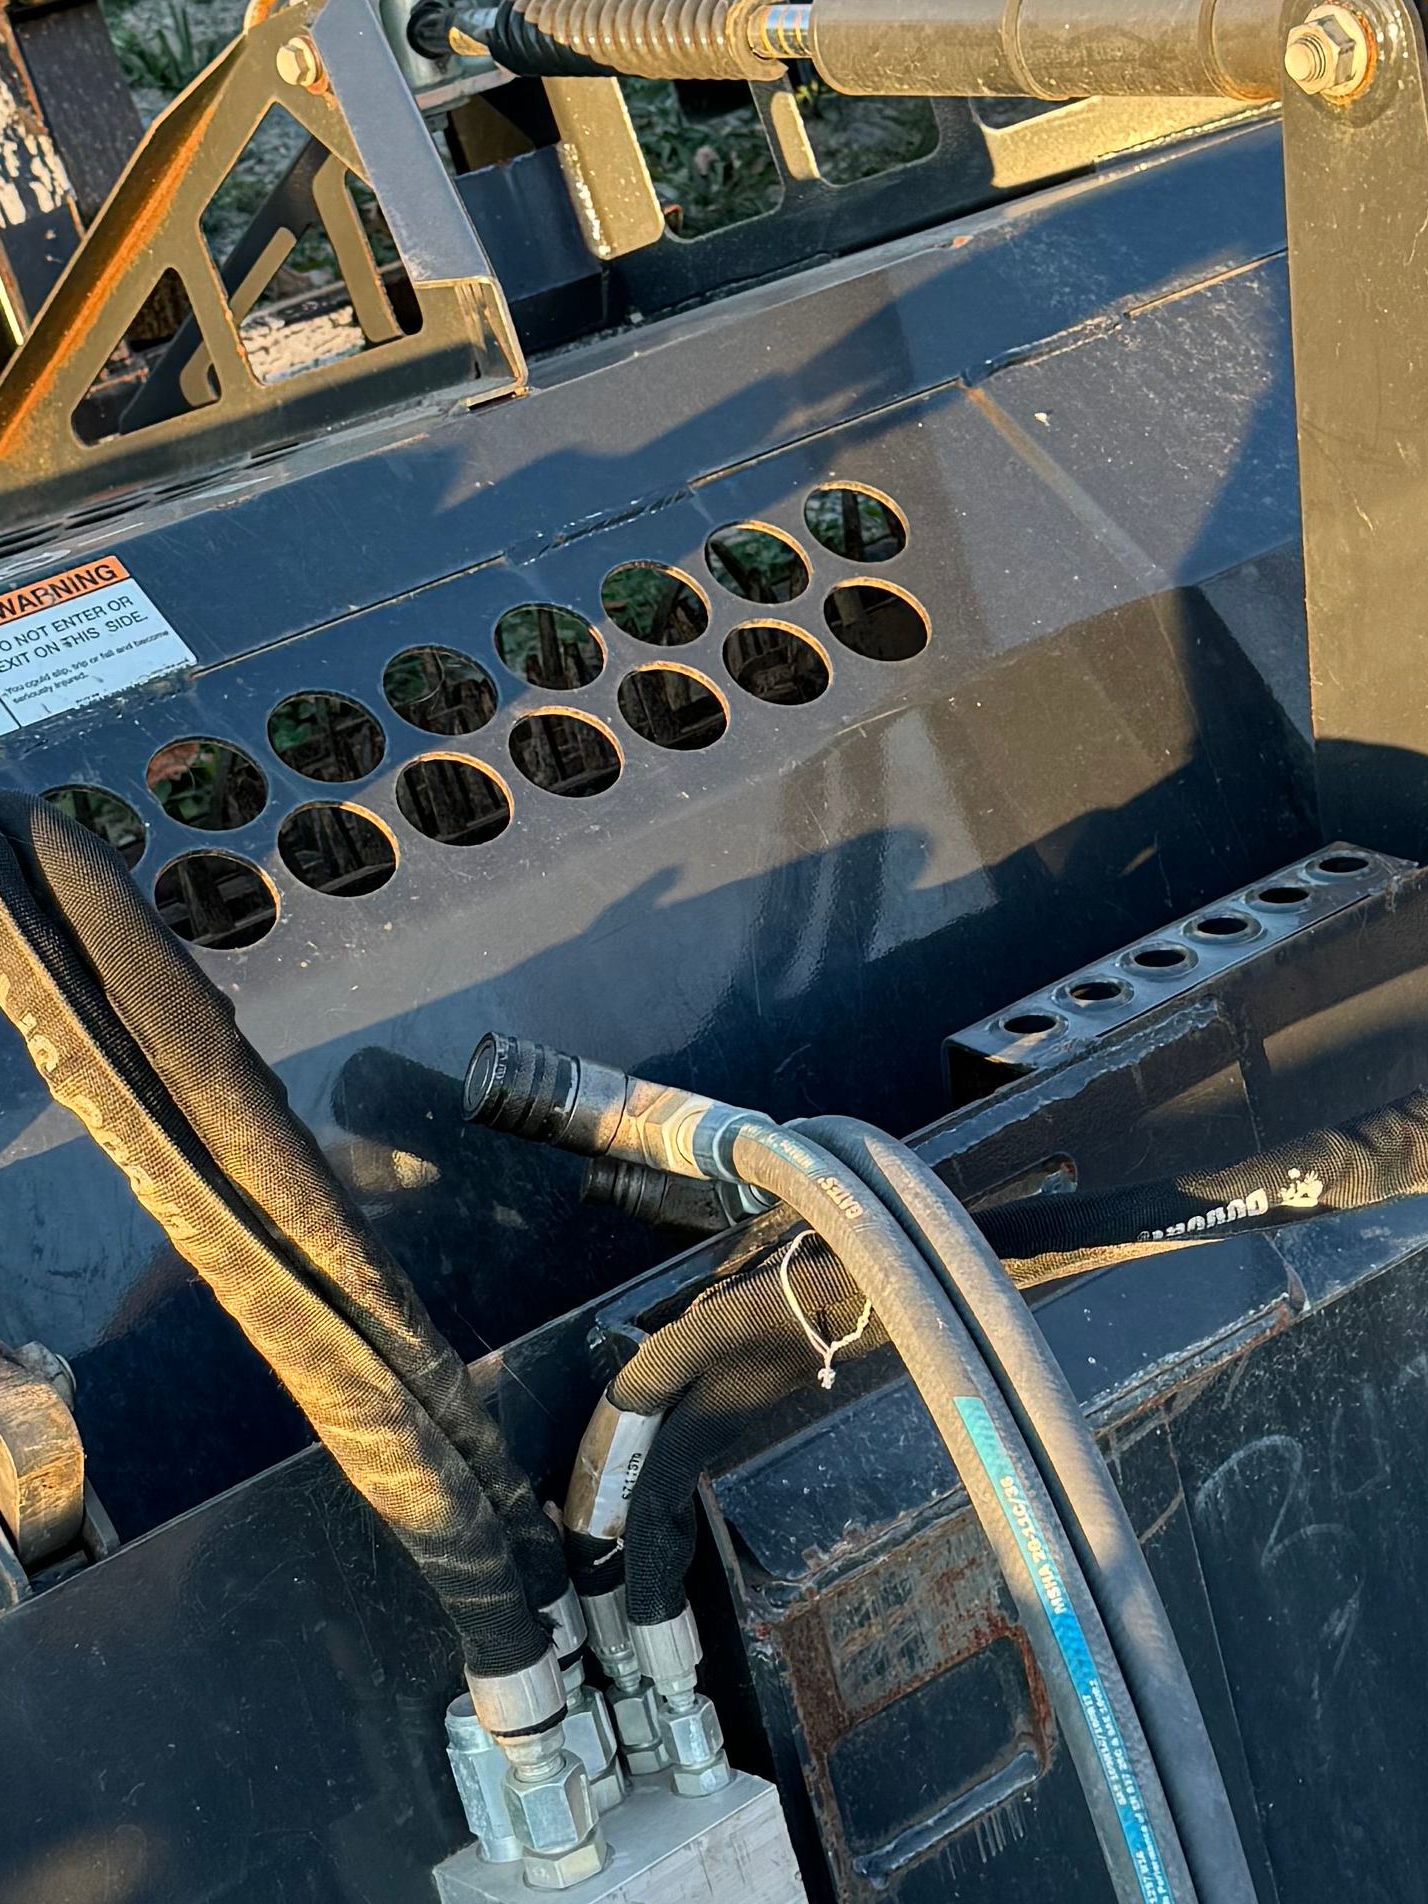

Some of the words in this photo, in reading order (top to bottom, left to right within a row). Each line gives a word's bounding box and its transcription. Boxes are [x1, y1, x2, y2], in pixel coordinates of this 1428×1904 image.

[15, 625, 49, 648] NOT
[52, 605, 106, 637] ENTER
[108, 595, 135, 615] OR
[39, 642, 61, 659] ON
[62, 626, 101, 649] THIS
[819, 1177, 863, 1219] GATES
[1038, 1564, 1068, 1615] MSHA
